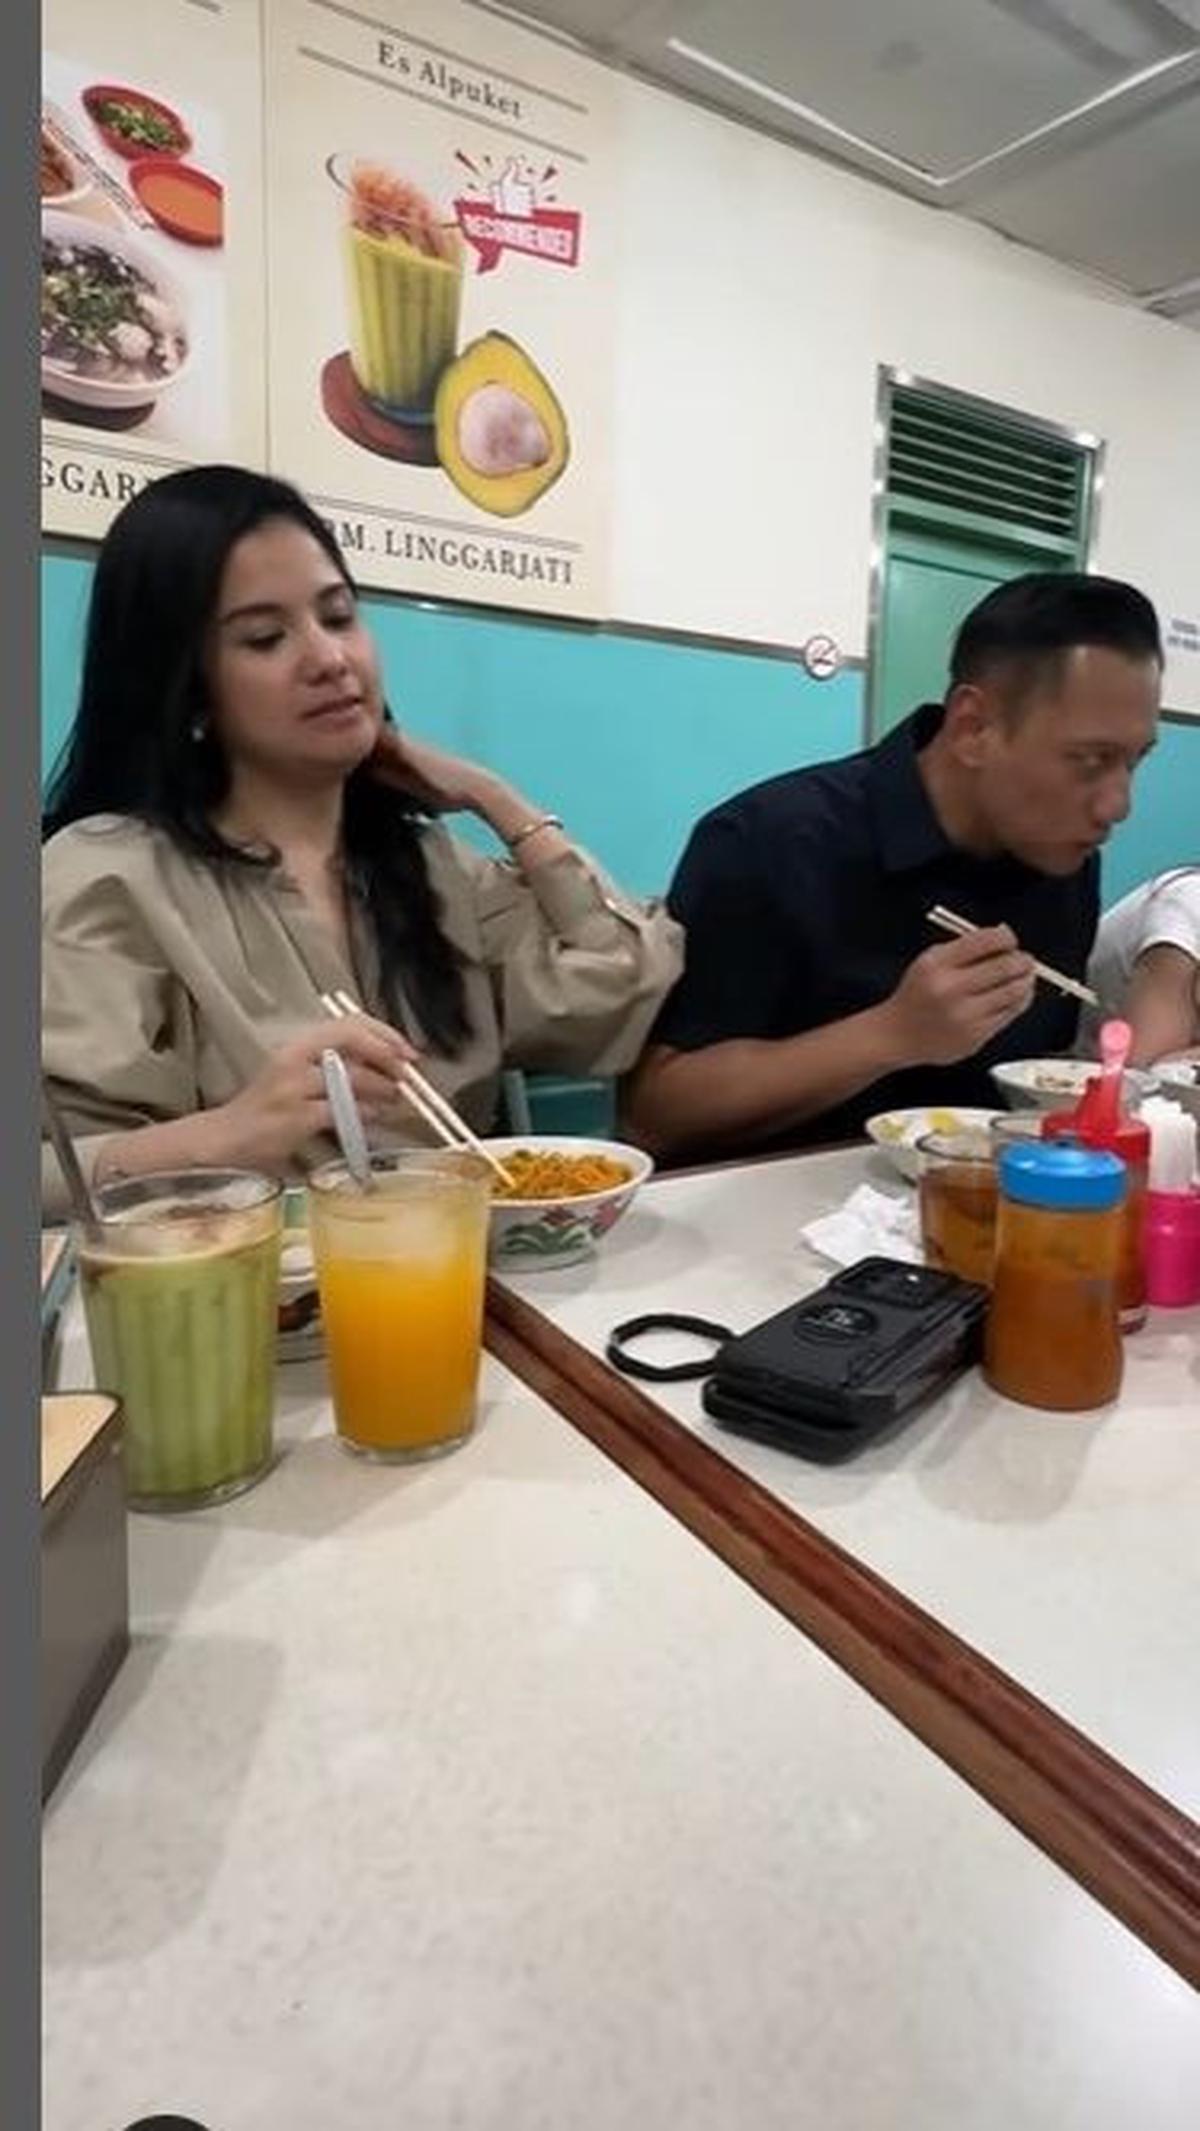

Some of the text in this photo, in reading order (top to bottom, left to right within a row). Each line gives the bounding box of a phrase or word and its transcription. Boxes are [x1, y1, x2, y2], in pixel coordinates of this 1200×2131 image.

[379, 40, 521, 119] Es Alpuket
[41, 458, 152, 500] GGAR
[385, 530, 572, 584] LINGGARJATI
